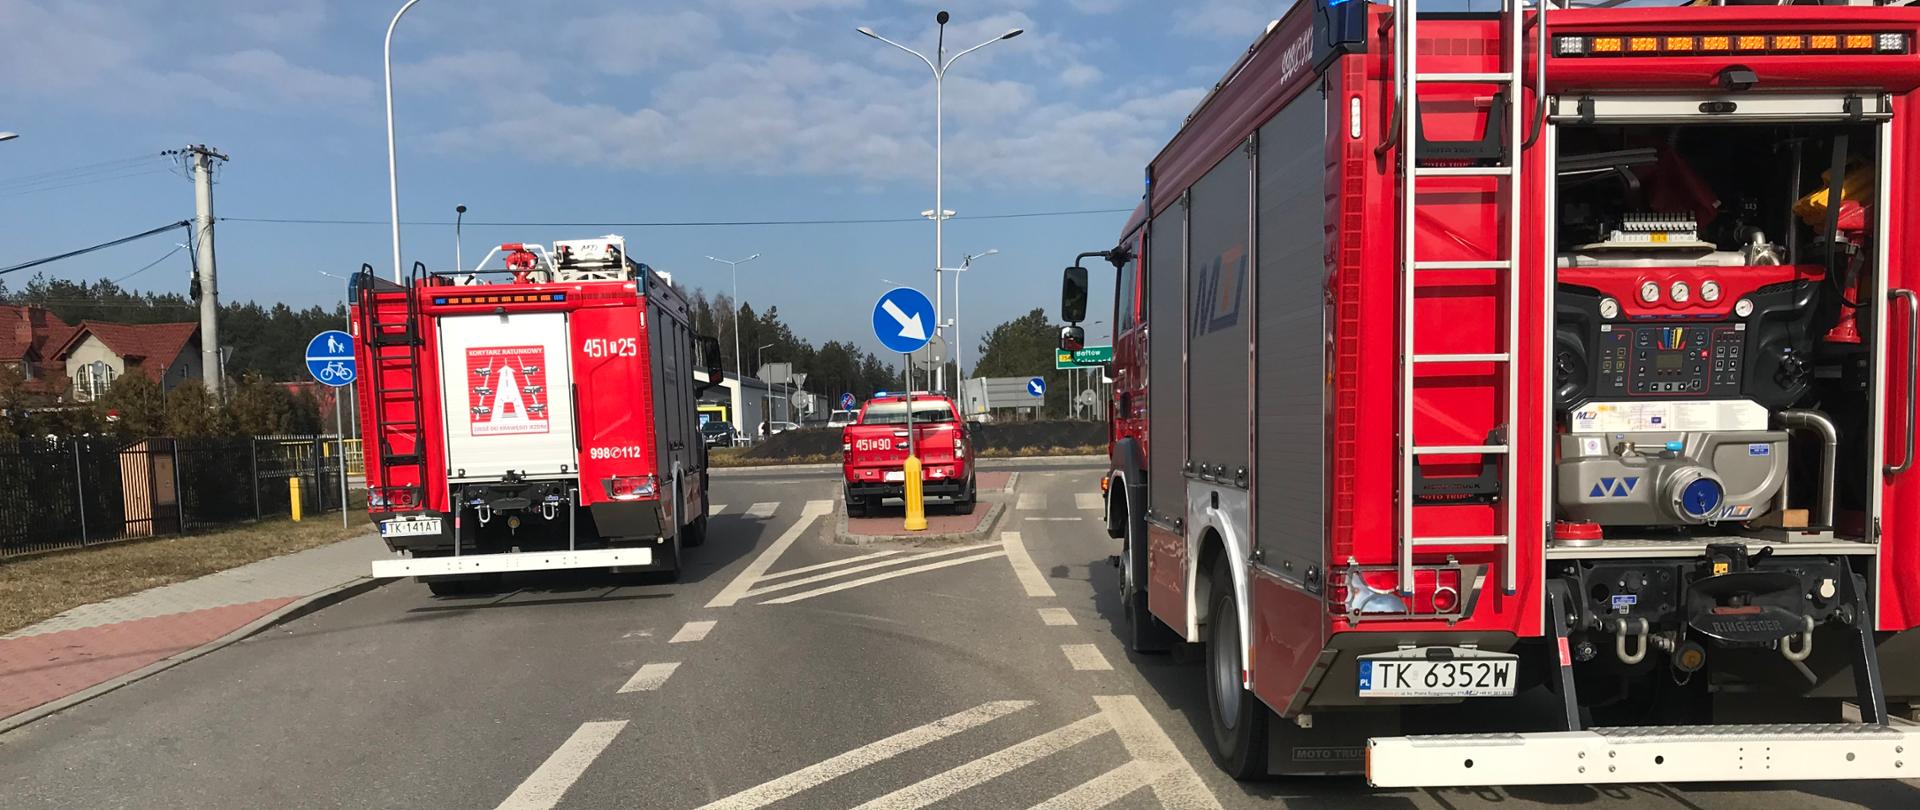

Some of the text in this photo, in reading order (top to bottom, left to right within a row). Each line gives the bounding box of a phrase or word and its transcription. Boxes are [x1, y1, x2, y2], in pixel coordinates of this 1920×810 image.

[468, 347, 543, 357] KORYTARZ RATUNKOWY
[590, 445, 641, 460] 998 112
[388, 520, 439, 534] TK 141AT
[1378, 662, 1510, 689] TK 6352W
[1360, 679, 1370, 687] PL
[1296, 749, 1331, 759] MOTO
